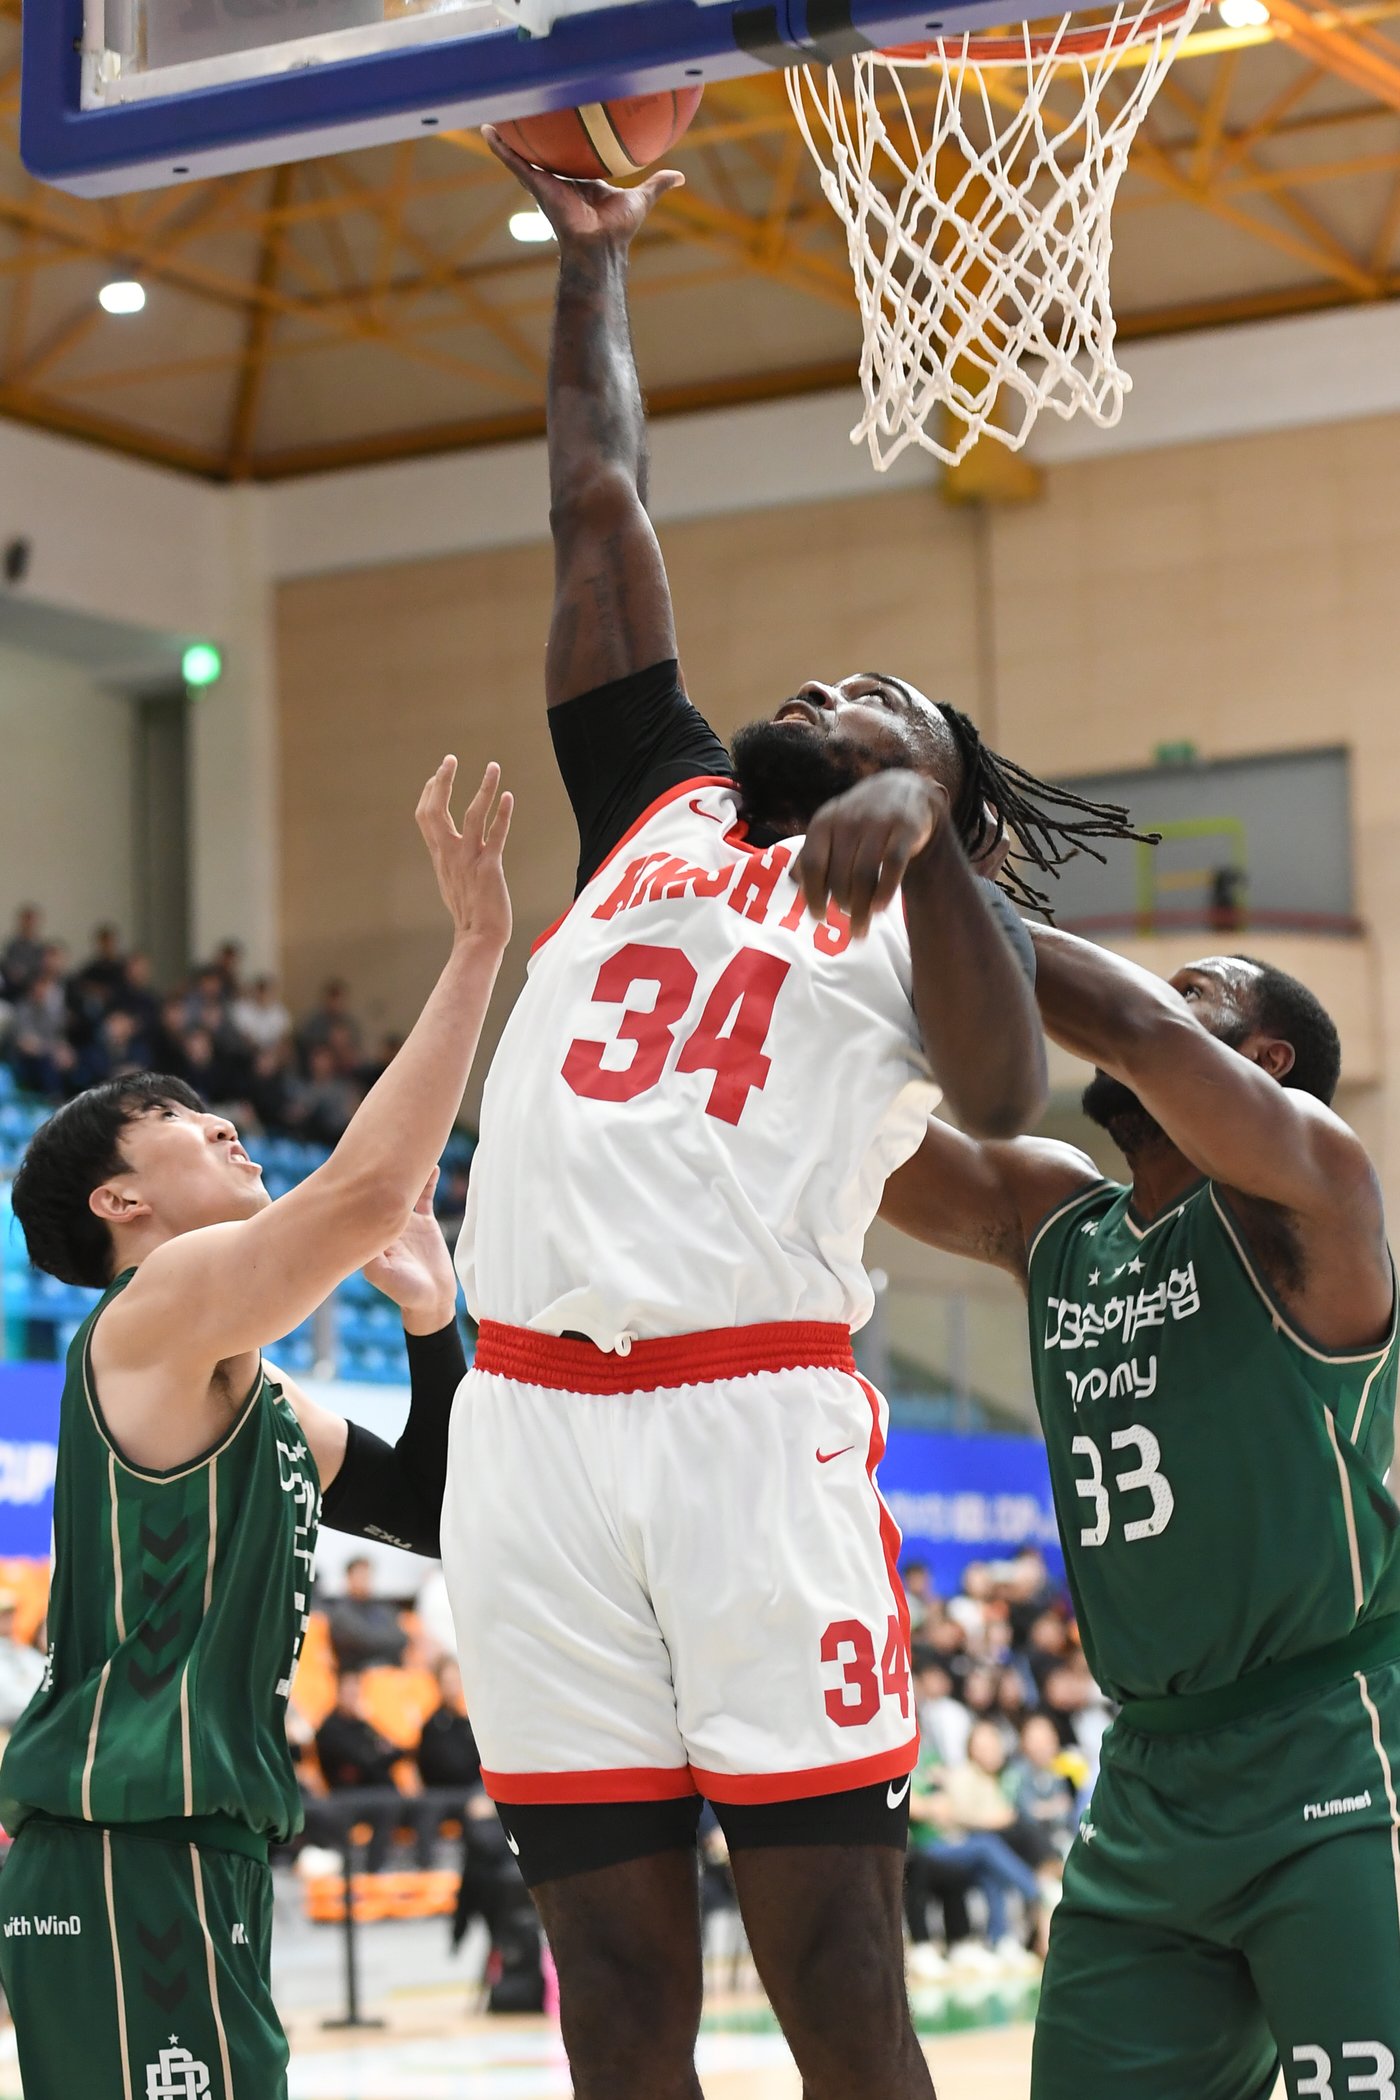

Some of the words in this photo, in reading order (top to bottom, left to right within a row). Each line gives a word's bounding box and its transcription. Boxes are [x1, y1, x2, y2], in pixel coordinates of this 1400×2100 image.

[561, 943, 791, 1126] 34
[1072, 1424, 1175, 1546] 33
[820, 1615, 910, 1727] 34
[1303, 1789, 1372, 1822] hummel
[3, 1915, 31, 1938] with
[33, 1915, 81, 1936] WinD
[1293, 2040, 1396, 2100] 33
